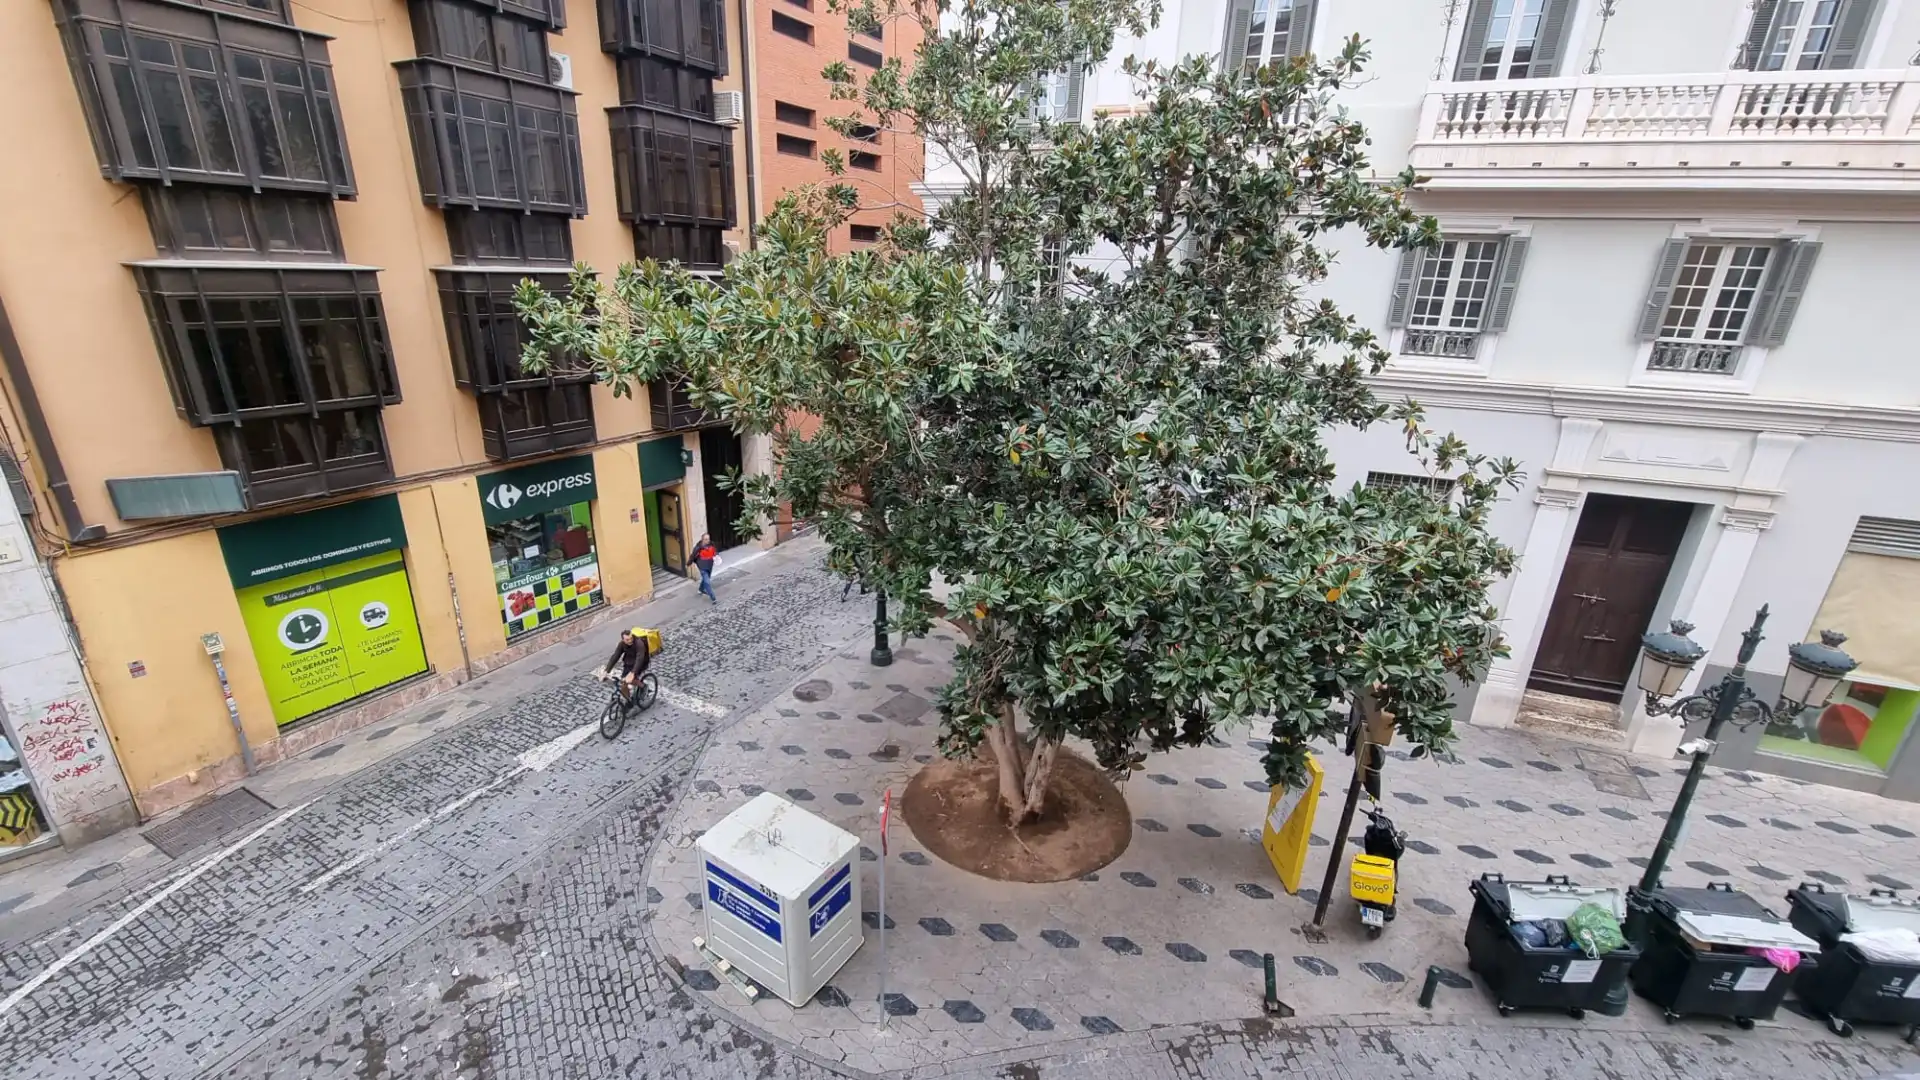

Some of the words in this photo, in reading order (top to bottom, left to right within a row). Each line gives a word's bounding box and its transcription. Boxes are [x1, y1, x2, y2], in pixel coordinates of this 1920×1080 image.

[526, 472, 592, 498] express
[251, 564, 284, 577] ABRIMOS
[284, 557, 308, 569] TODOS
[308, 555, 322, 563] LOS
[323, 546, 358, 559] DOMINGOS
[363, 537, 392, 549] FESTIVOS
[501, 571, 544, 591] Carrefour
[561, 556, 592, 571] express
[280, 653, 318, 670] ABRIMOS
[319, 645, 344, 657] TODA
[363, 645, 373, 653] LA
[290, 666, 302, 676] LA
[302, 655, 338, 671] SEMANA
[292, 672, 314, 684] PARA
[313, 663, 340, 677] VERTE
[300, 677, 323, 689] CADA
